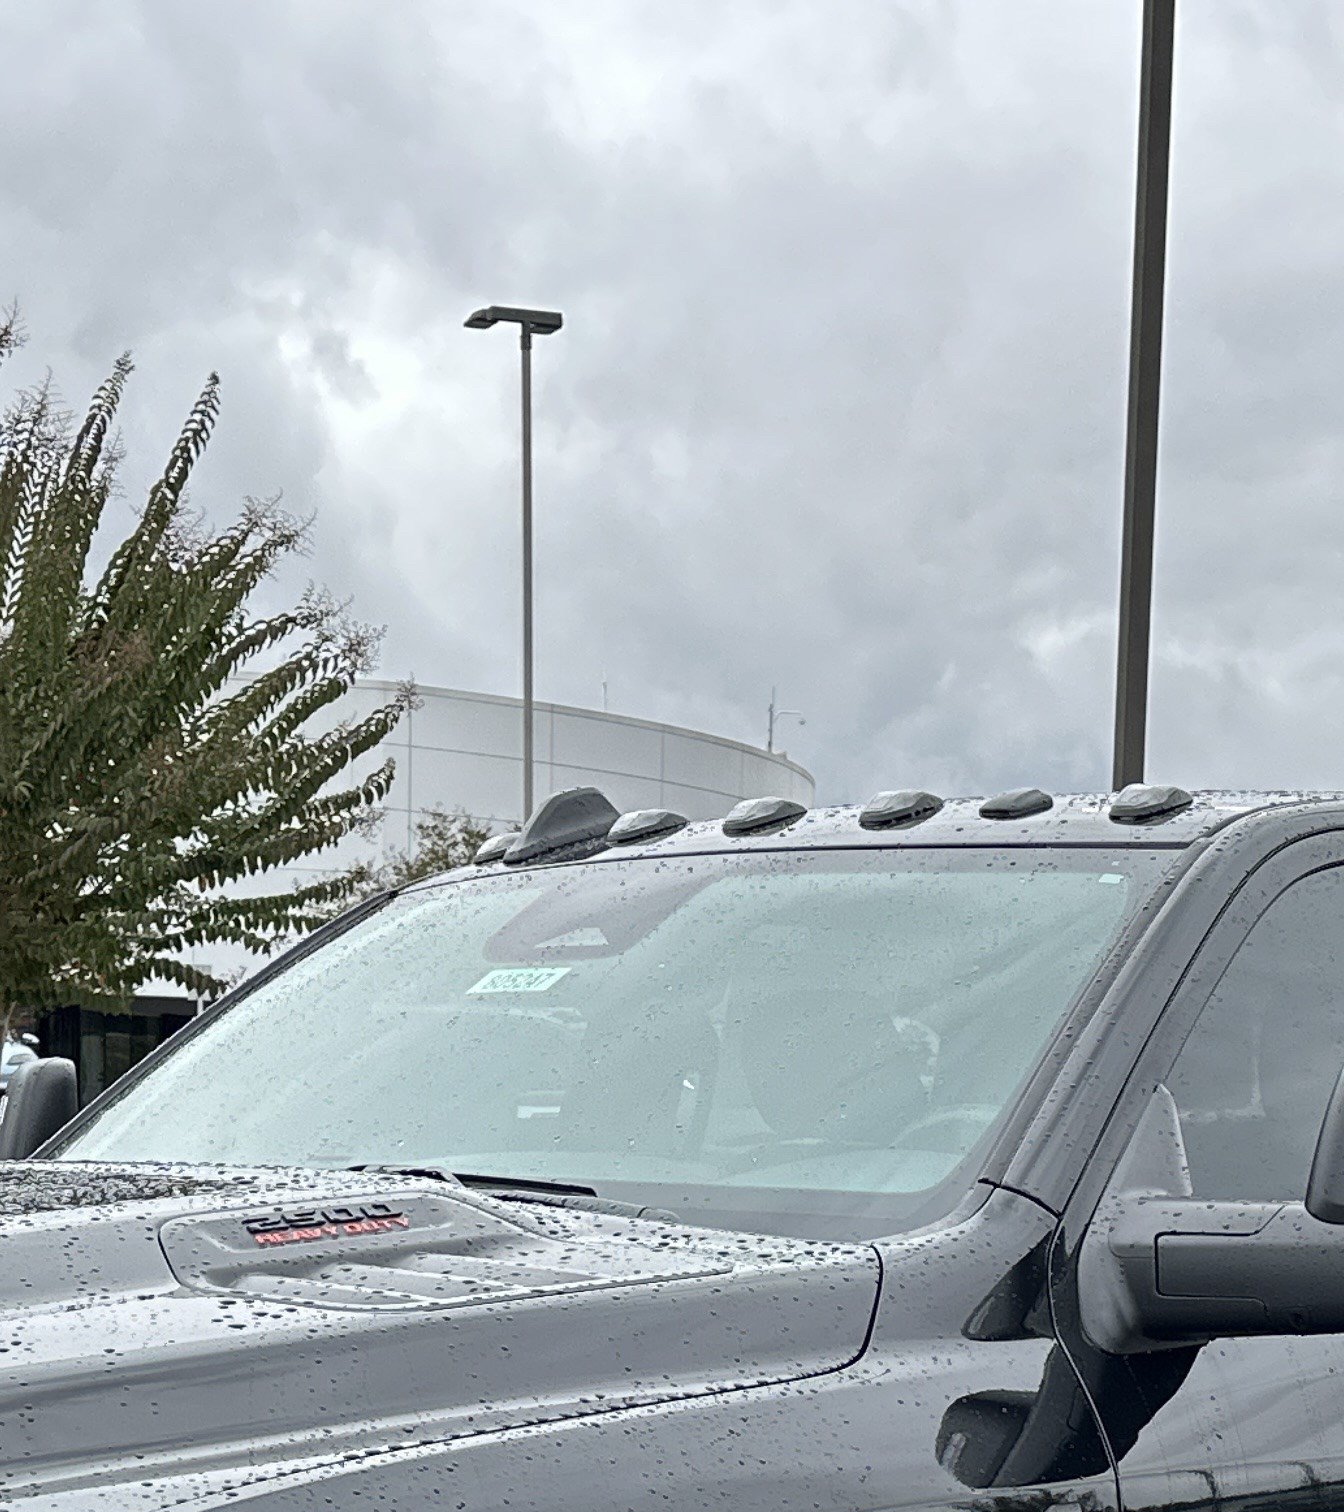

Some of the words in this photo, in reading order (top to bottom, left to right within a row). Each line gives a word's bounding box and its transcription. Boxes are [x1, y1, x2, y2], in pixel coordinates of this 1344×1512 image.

[241, 1204, 403, 1234] 2500
[254, 1225, 339, 1246] HEAVY
[343, 1216, 410, 1237] DUTY
